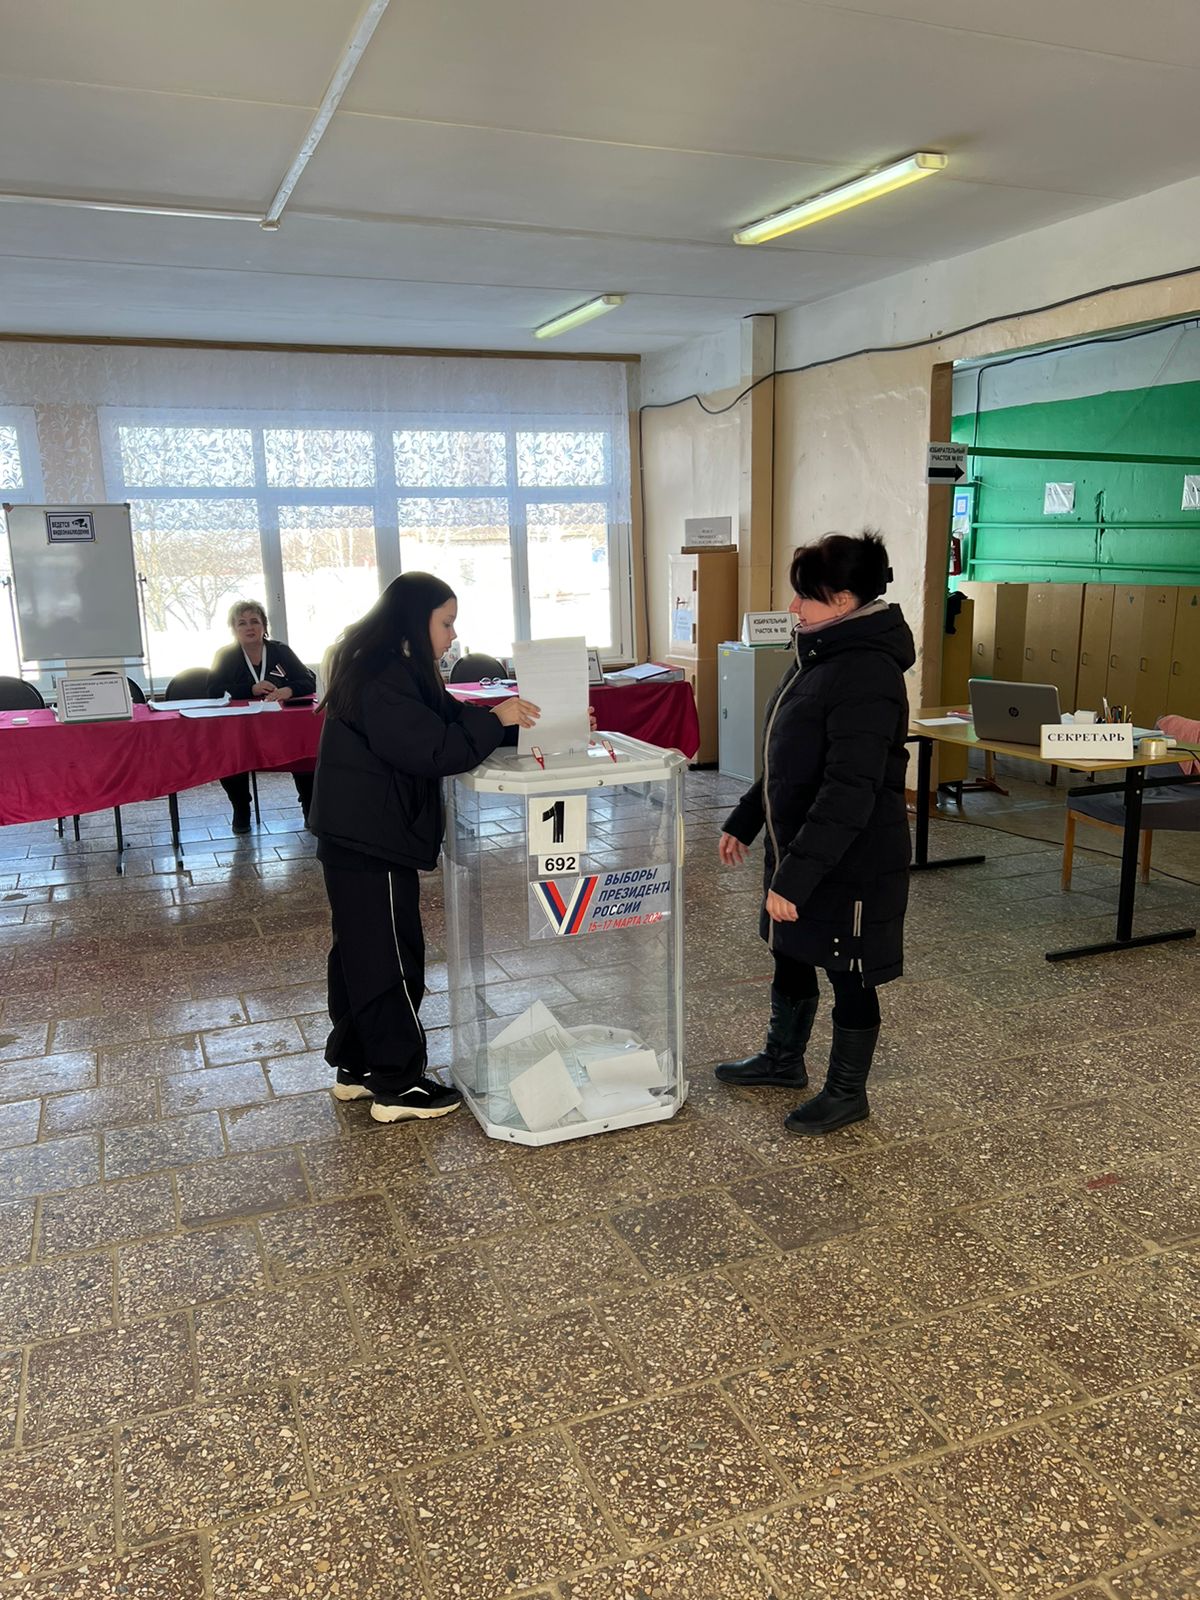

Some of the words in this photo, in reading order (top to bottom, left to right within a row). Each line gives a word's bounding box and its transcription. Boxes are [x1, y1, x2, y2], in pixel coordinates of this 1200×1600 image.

[1047, 733, 1125, 742] СЕКРЕТАРЬ
[542, 801, 565, 843] 1
[545, 856, 576, 872] 692
[604, 868, 658, 886] ВЫБОРЫ
[598, 881, 670, 902] ПРЕЗИДЕНТА
[592, 901, 642, 918] РОССИИ
[613, 916, 642, 929] МАРТА
